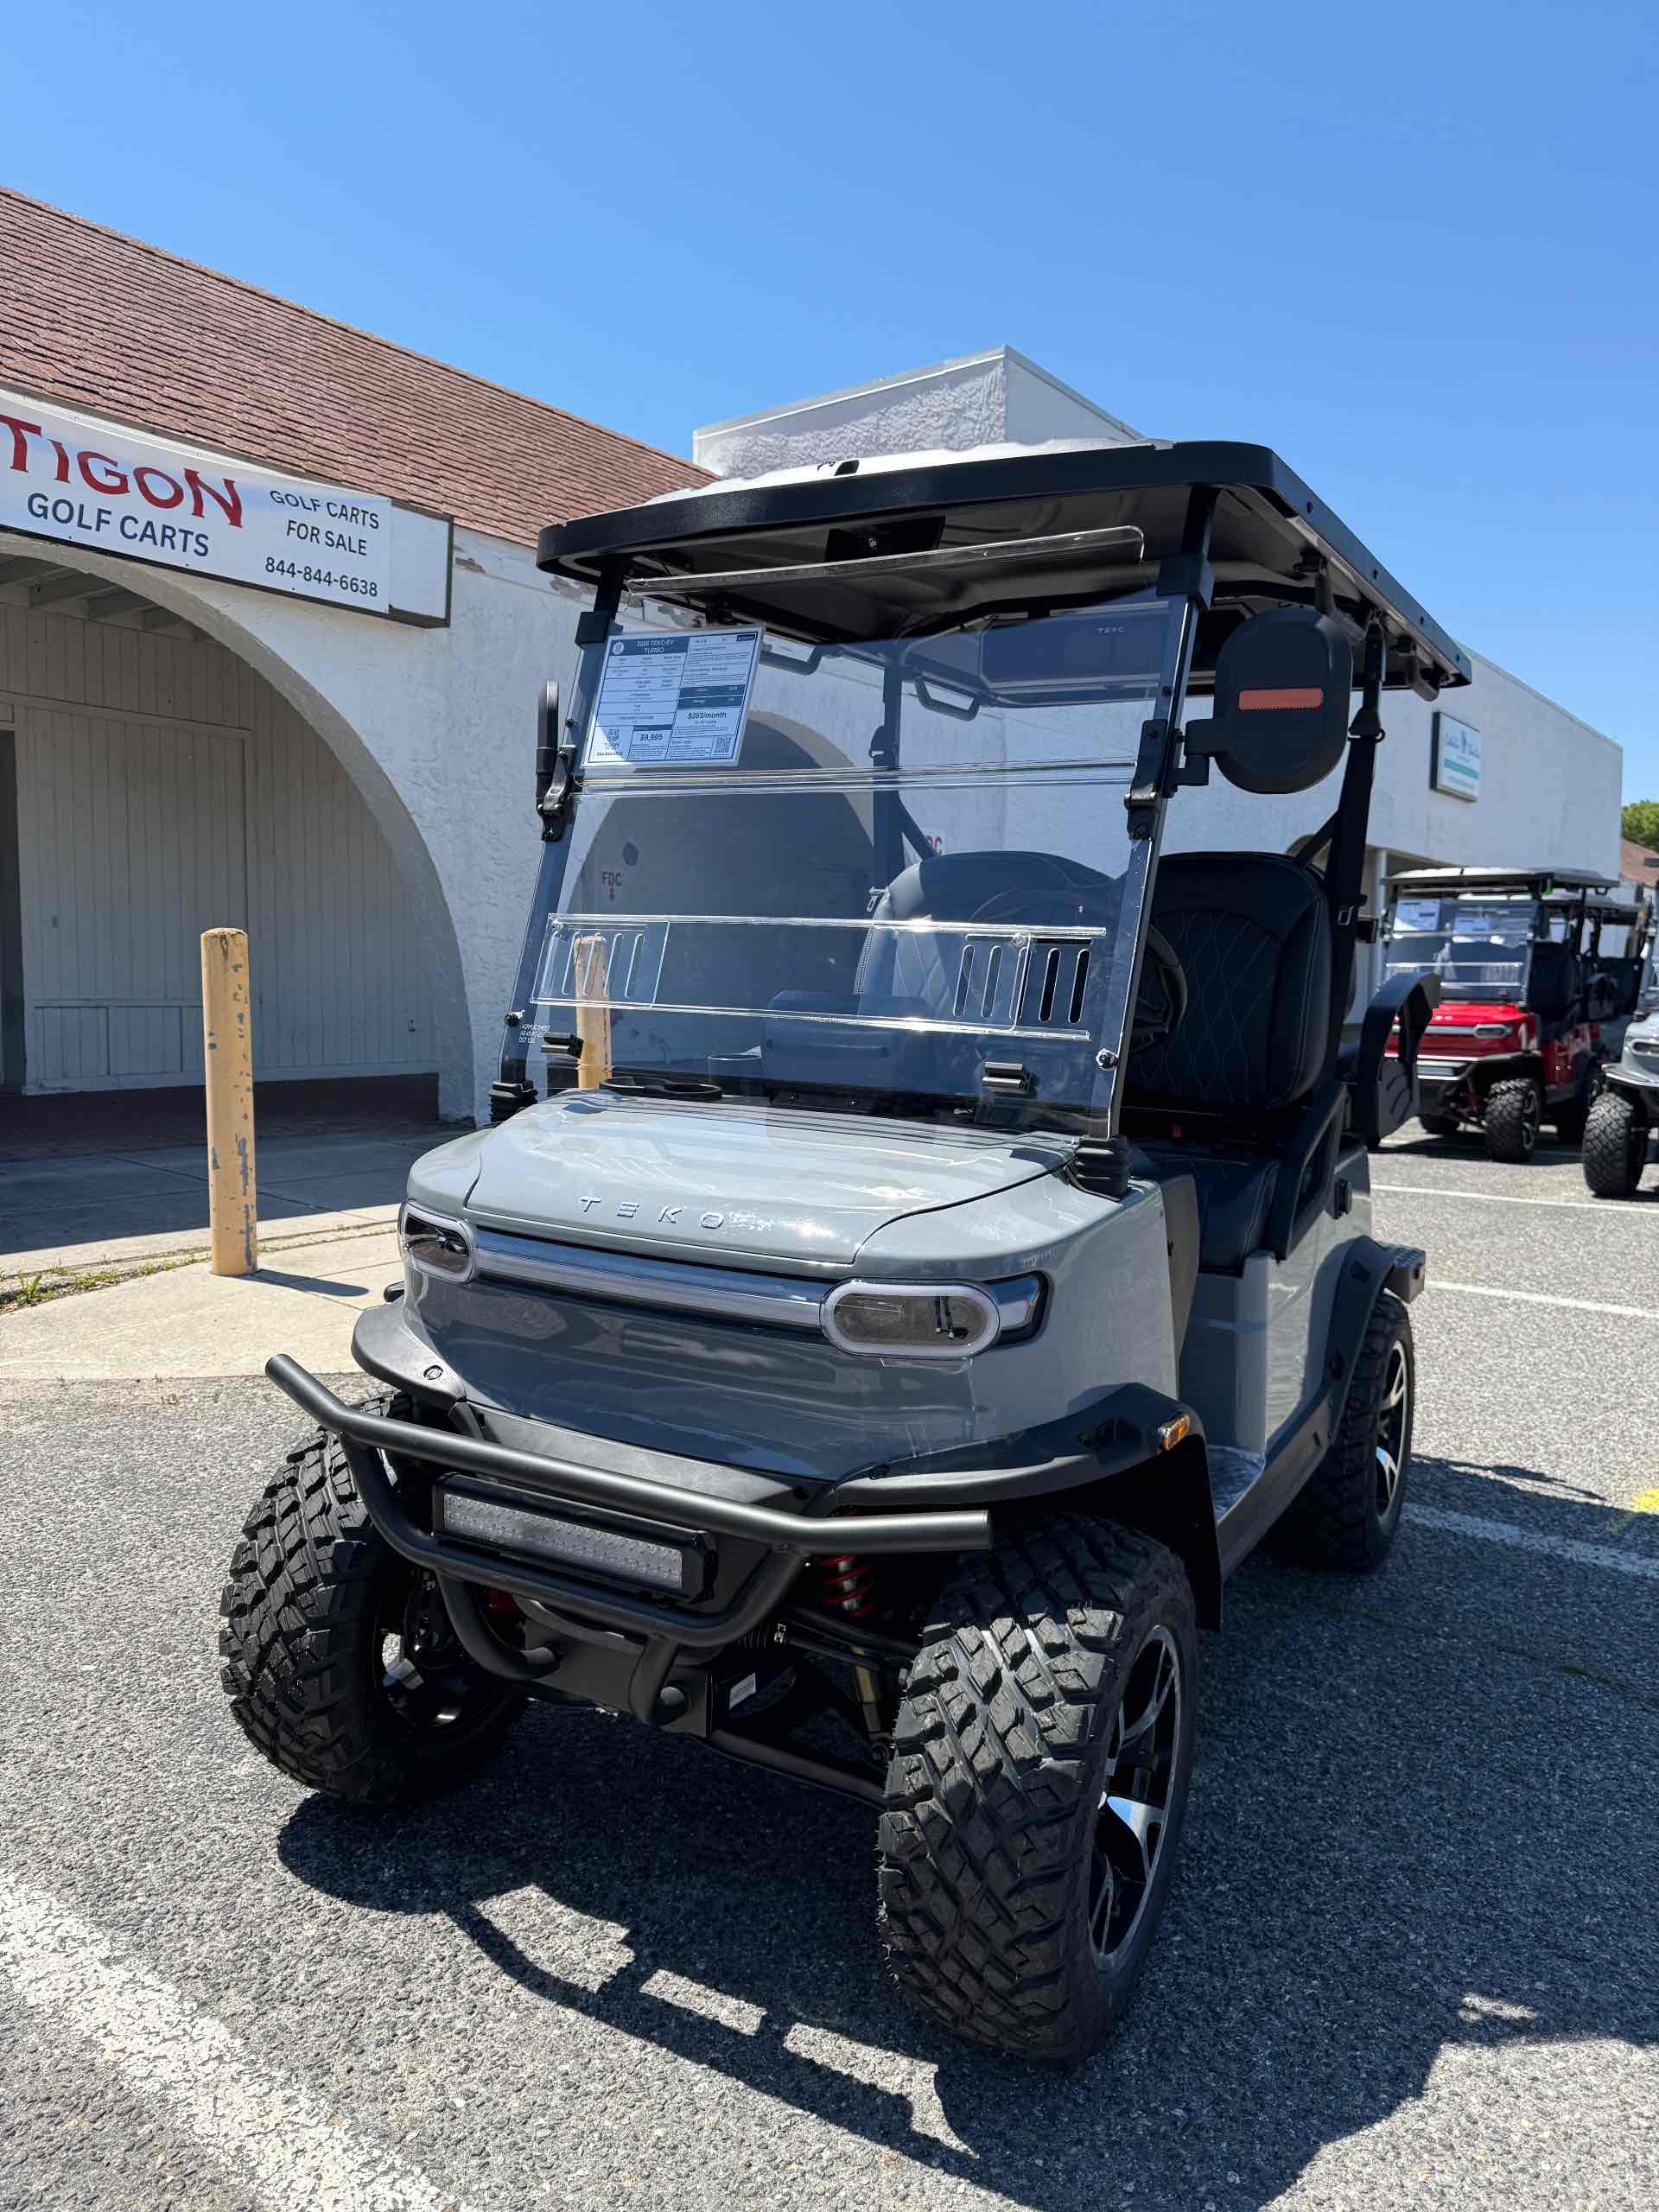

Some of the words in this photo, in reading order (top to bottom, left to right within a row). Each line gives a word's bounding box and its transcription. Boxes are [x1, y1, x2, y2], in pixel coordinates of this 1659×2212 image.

[0, 415, 243, 528] TIGON
[28, 493, 112, 532] GOLF
[120, 515, 209, 557] CARTS
[270, 490, 321, 512] GOLF
[326, 501, 379, 530] CARTS
[286, 519, 321, 544] FOR
[324, 530, 367, 556] SALE
[265, 556, 378, 597] 844-844-6638
[601, 870, 622, 887] FDC
[580, 1195, 724, 1229] TEKO
